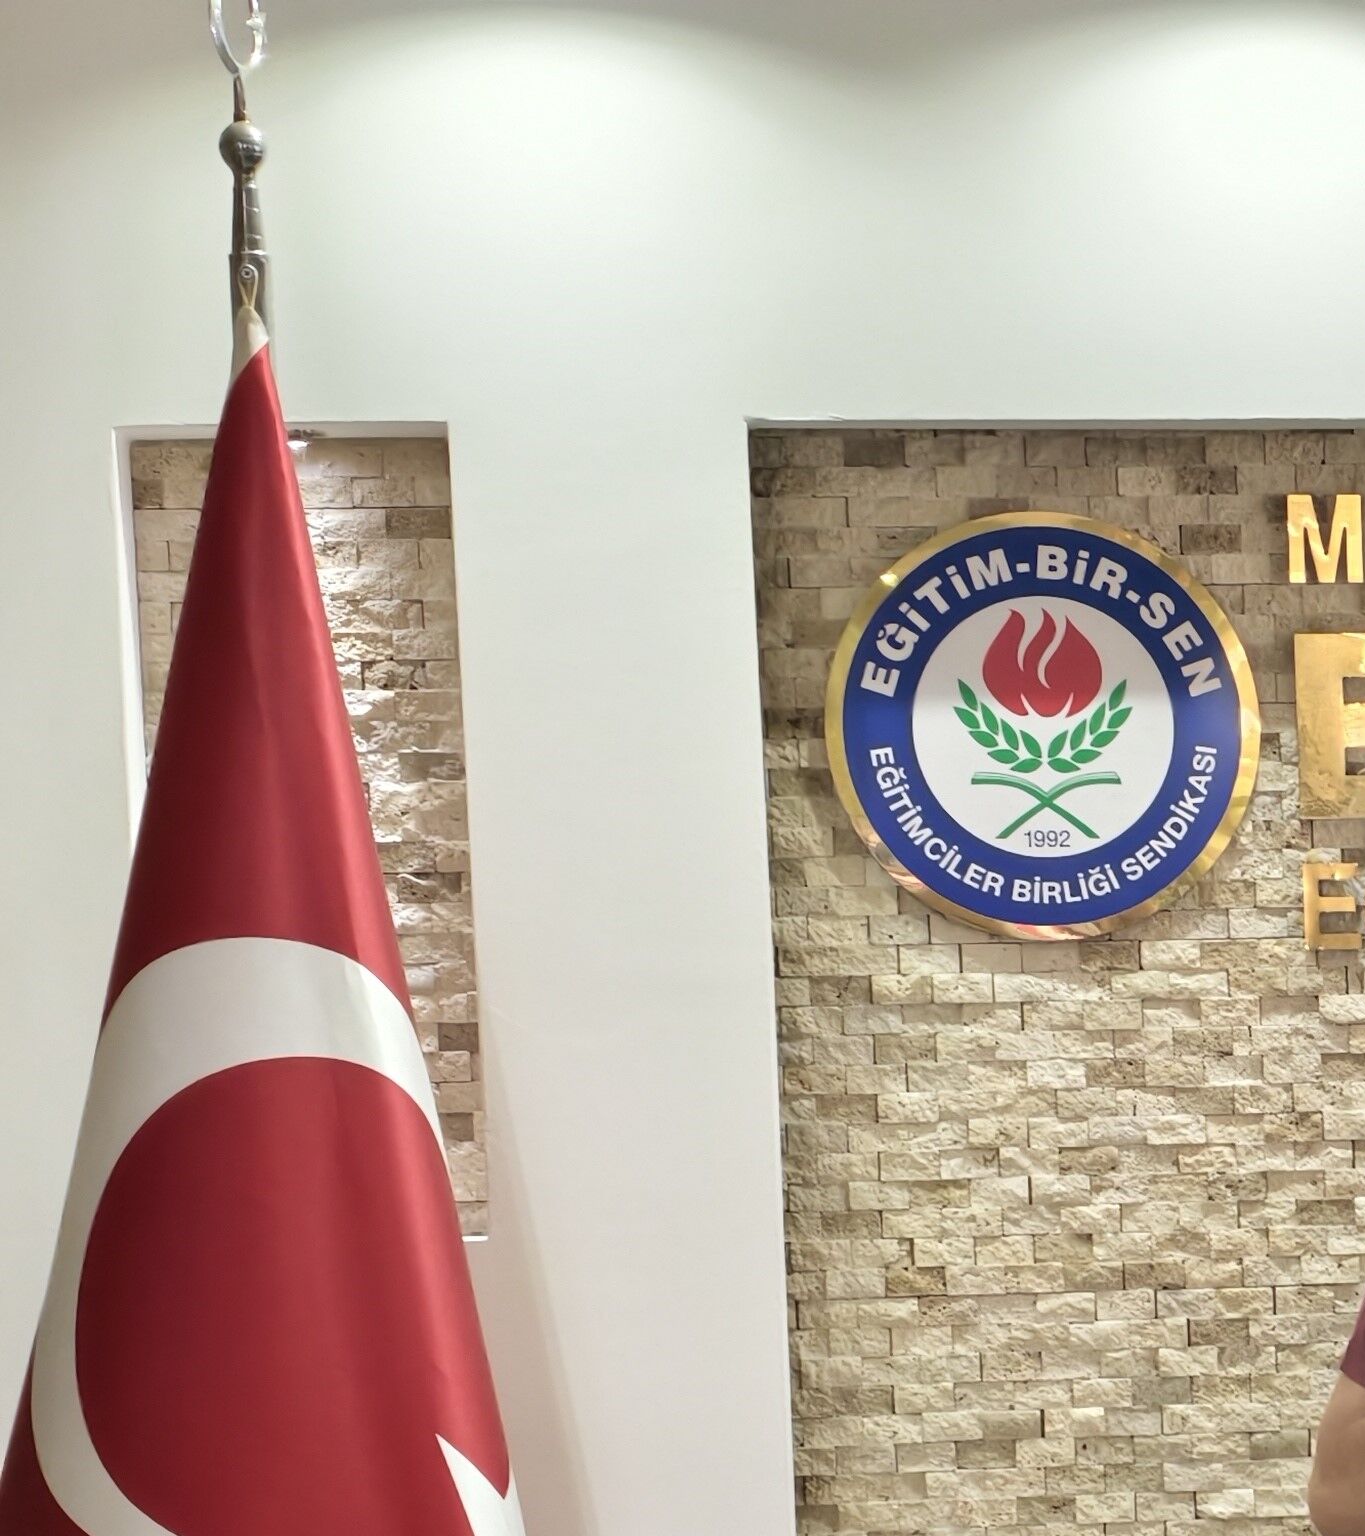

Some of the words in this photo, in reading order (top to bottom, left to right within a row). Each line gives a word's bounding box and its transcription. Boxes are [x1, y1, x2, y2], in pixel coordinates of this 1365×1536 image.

[869, 746, 1004, 897] EĞİTİMCİLER
[1011, 866, 1121, 904] BİRLİĞİ
[1123, 744, 1218, 881] SENDİKASI
[1023, 829, 1071, 848] 1992
